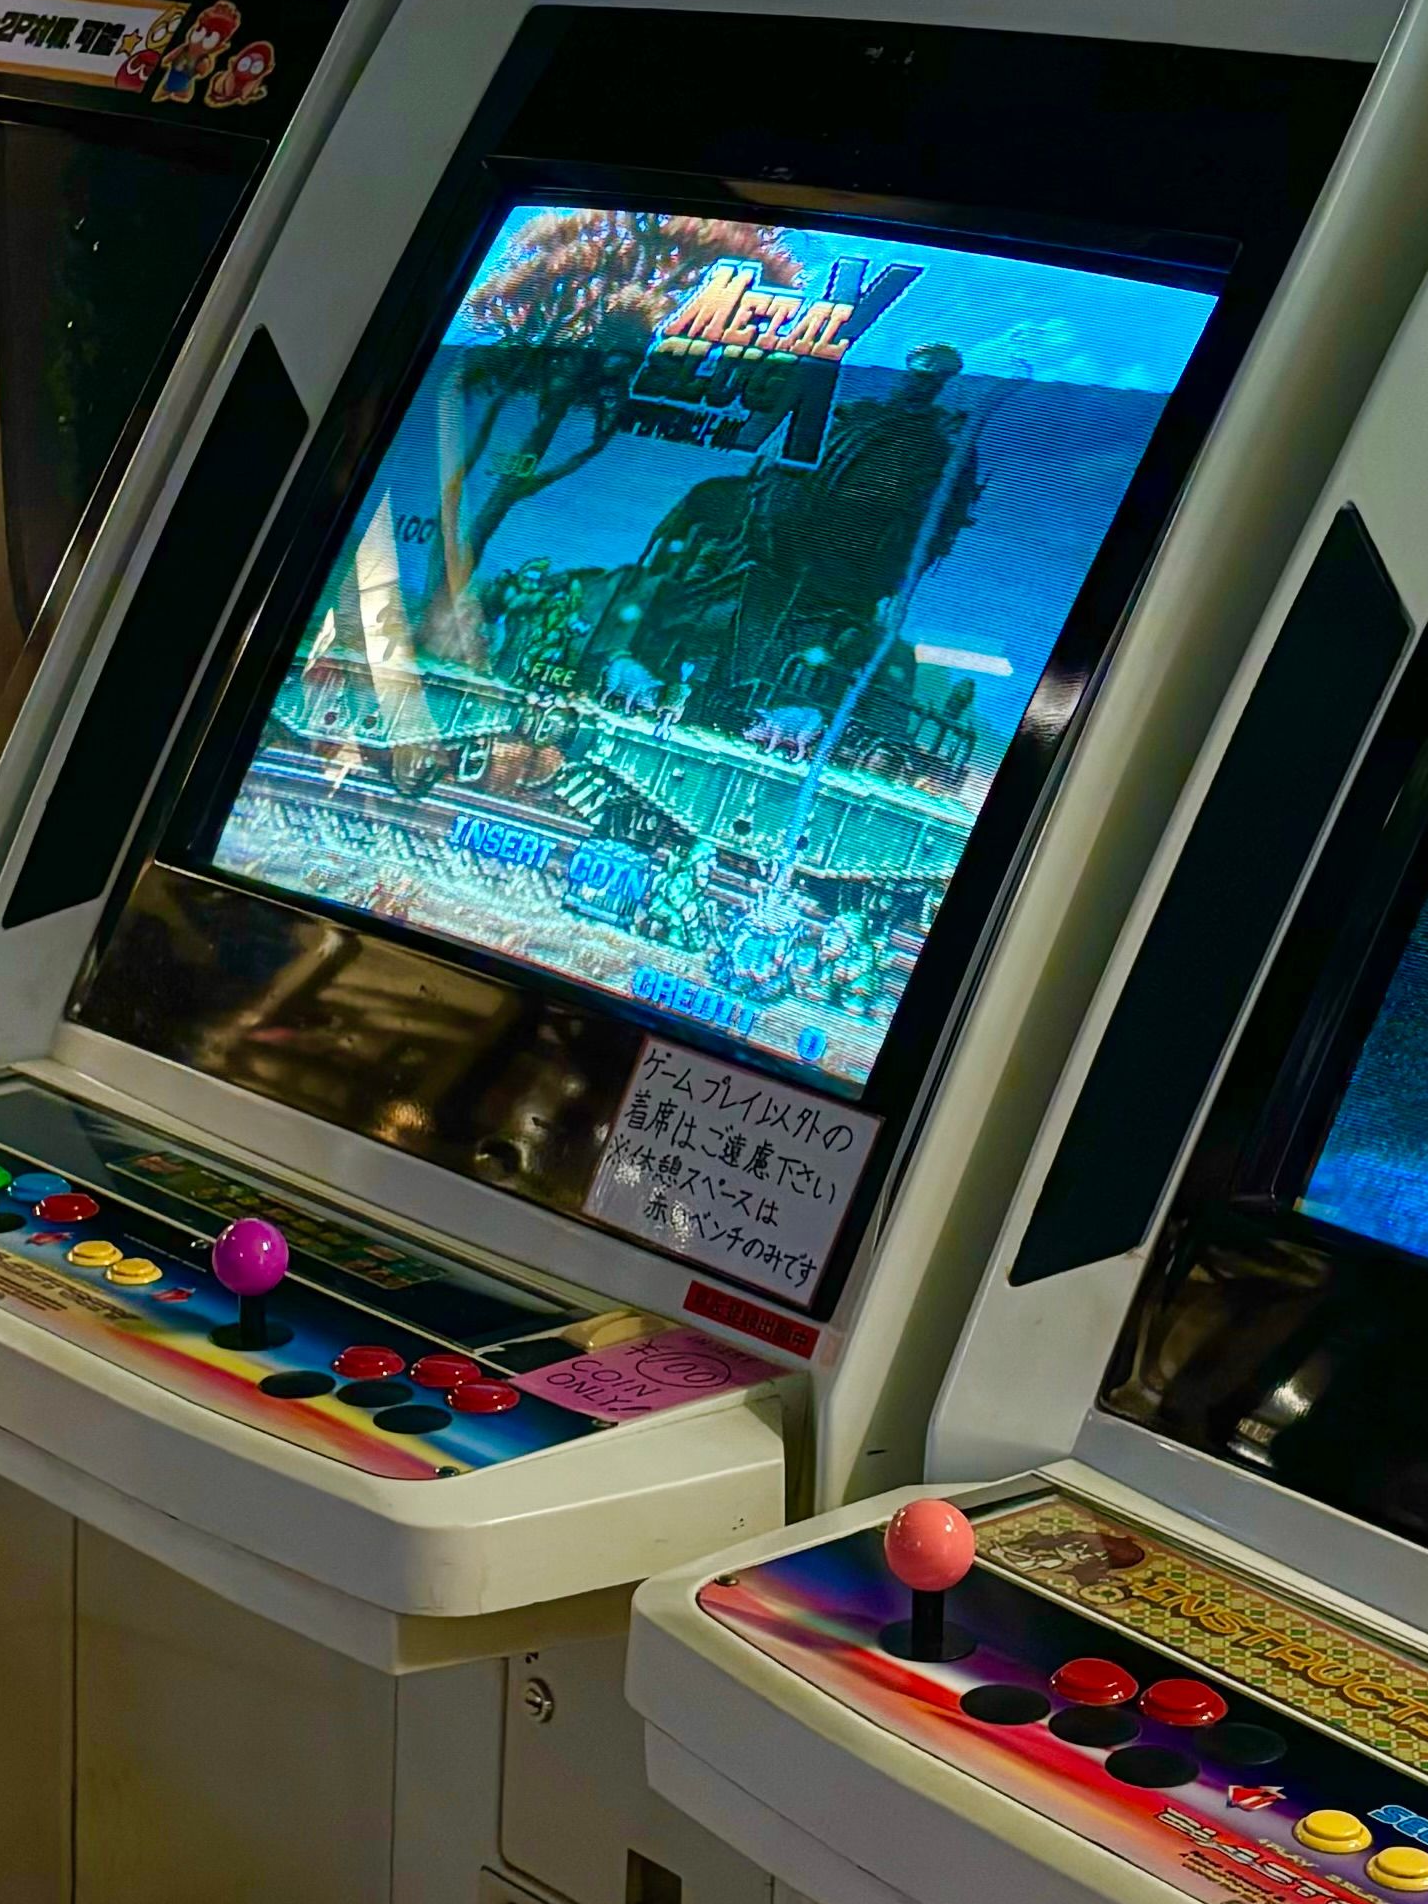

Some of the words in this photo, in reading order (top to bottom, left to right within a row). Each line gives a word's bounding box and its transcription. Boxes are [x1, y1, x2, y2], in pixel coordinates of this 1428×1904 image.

[662, 263, 857, 363] METAL
[449, 815, 557, 869] INSERT
[568, 848, 651, 903] COIN
[625, 1089, 837, 1205] 着席はご遠慮下さい
[643, 1048, 853, 1153] ゲームプレイ以外の
[547, 1372, 652, 1413] ONLY!
[571, 1359, 661, 1398] COIN
